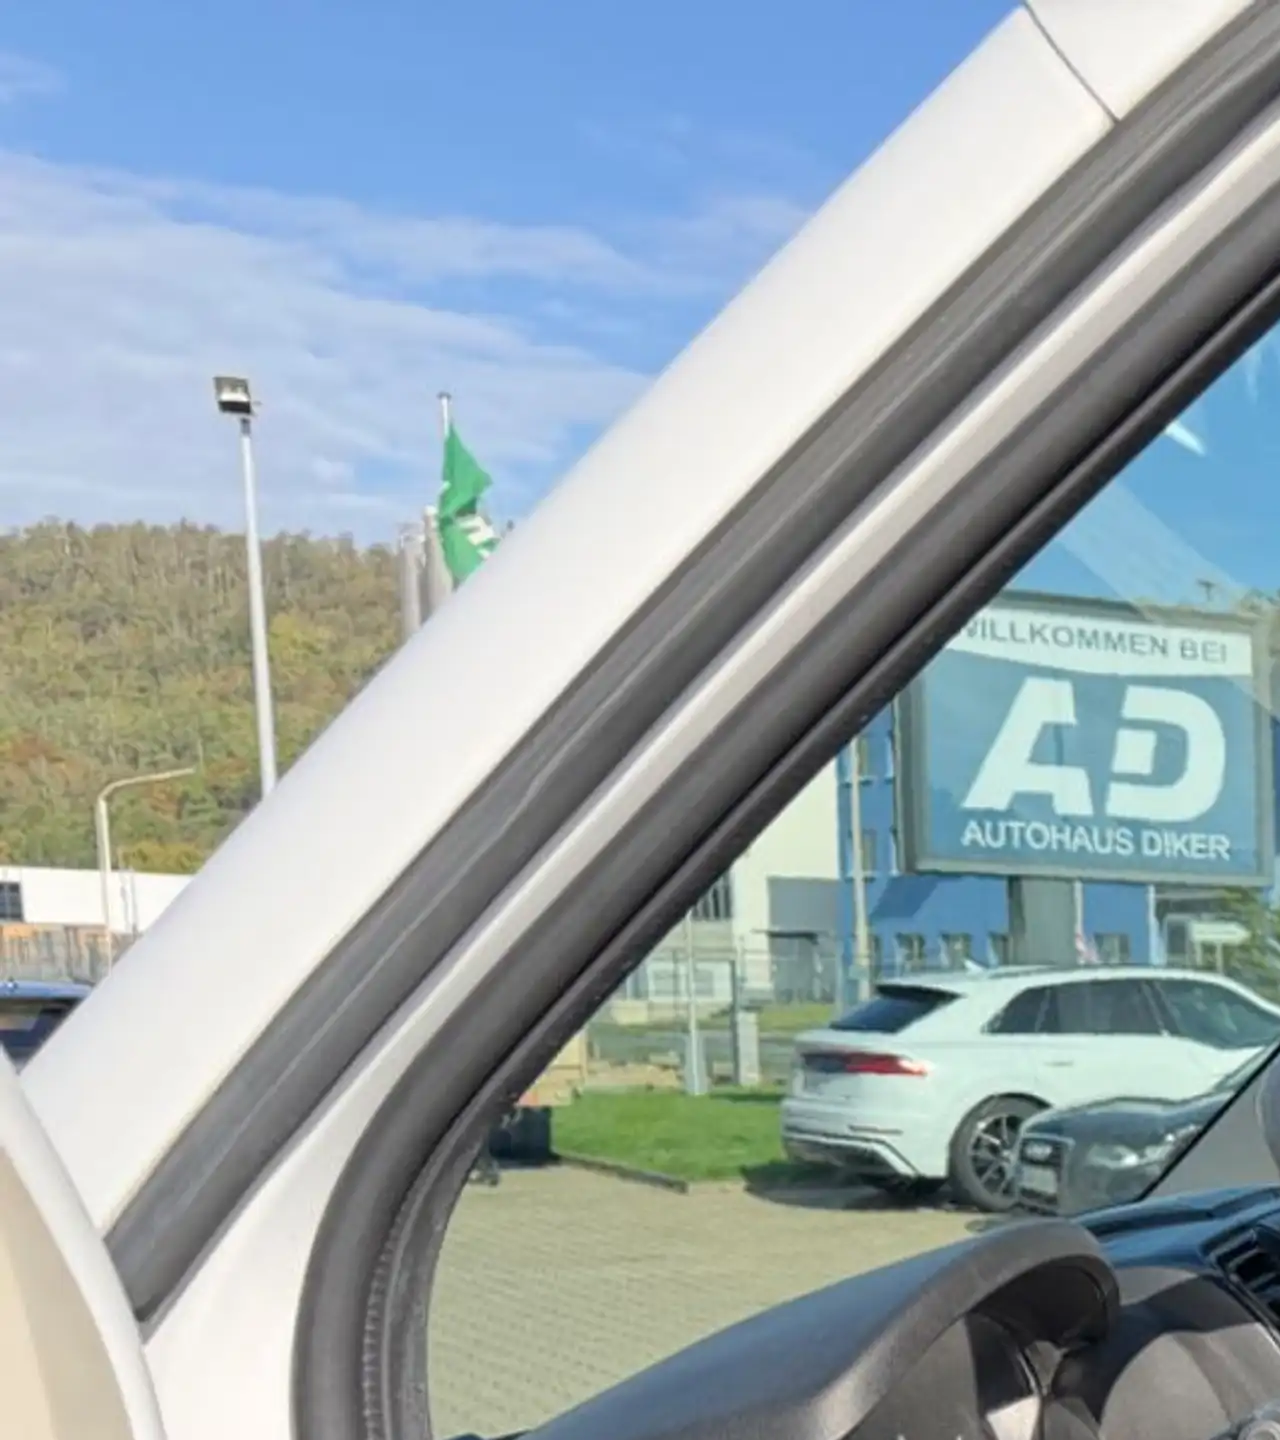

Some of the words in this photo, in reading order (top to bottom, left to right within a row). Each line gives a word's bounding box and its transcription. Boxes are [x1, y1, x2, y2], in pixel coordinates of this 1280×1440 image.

[1180, 637, 1228, 664] BEI
[960, 820, 1134, 855] AUTOHAUS
[1141, 829, 1231, 861] DIKER
